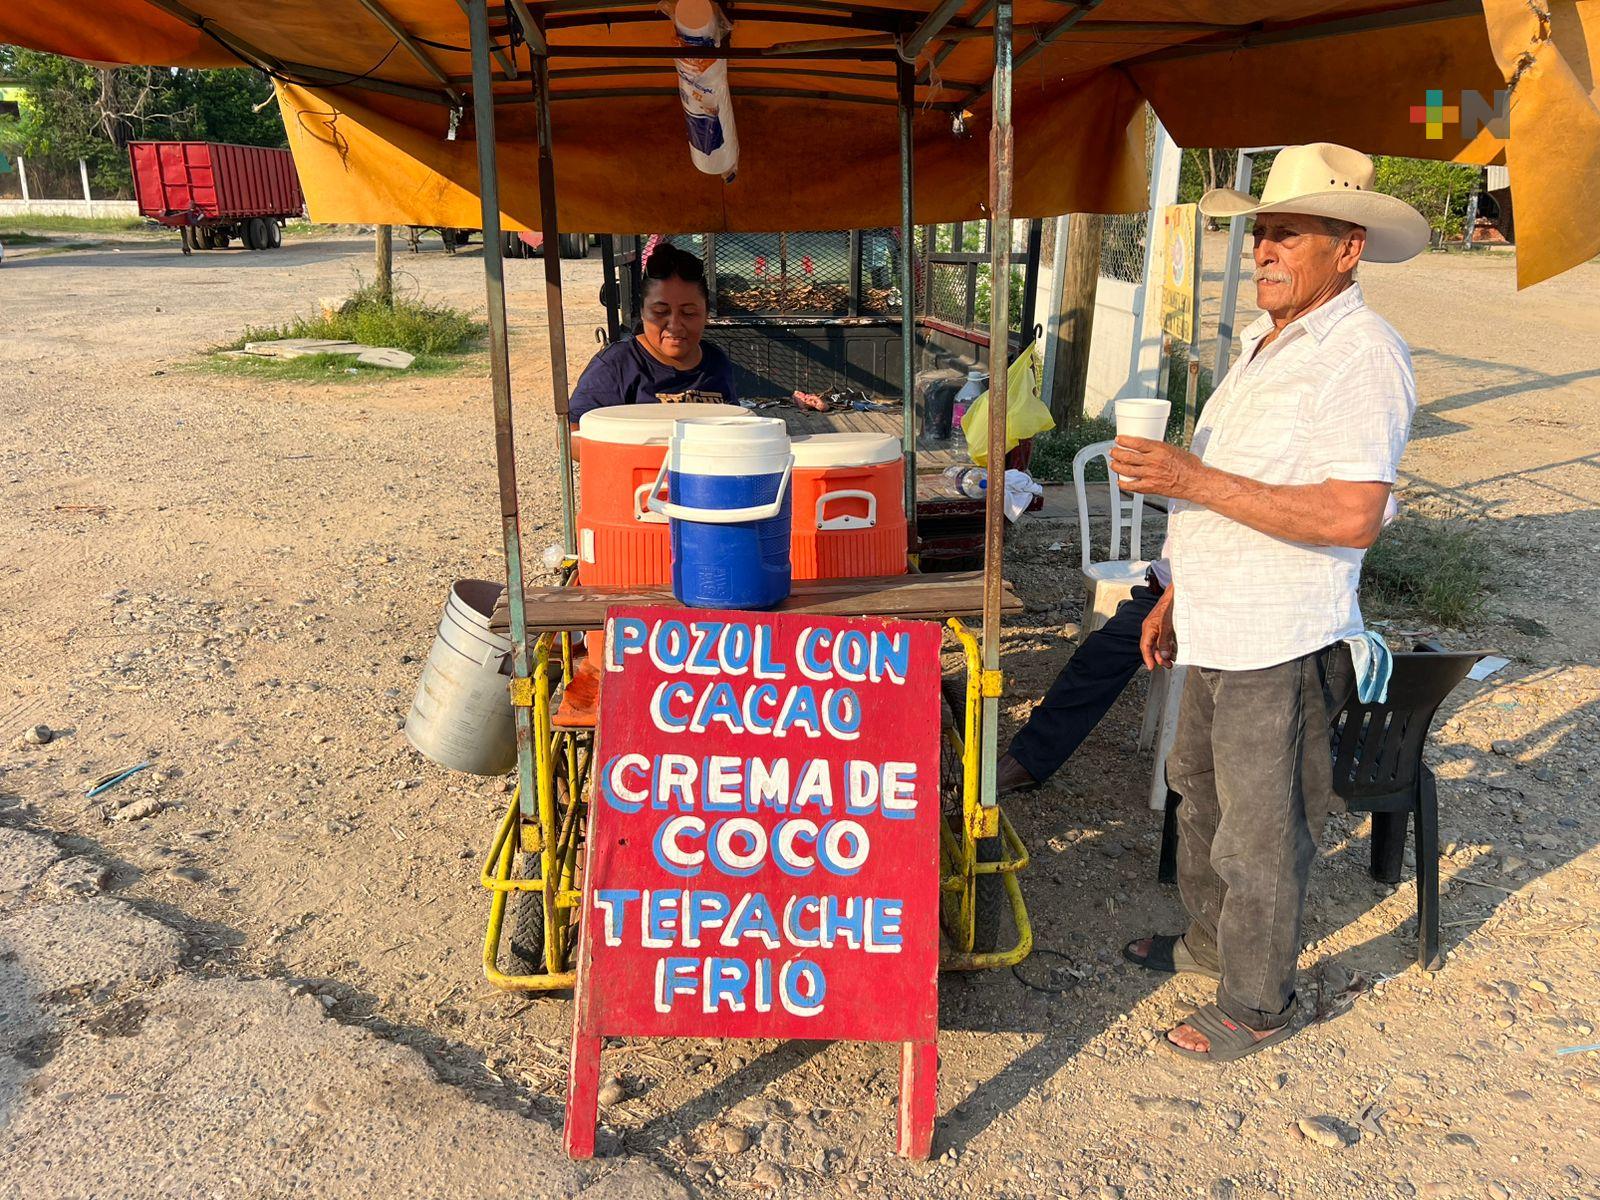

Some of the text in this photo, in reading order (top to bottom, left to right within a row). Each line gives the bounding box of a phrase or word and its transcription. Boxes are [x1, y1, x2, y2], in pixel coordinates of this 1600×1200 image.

[604, 617, 910, 684] POZOL CON
[649, 680, 862, 741] CACAO
[602, 753, 918, 819] CREMA DE
[652, 814, 871, 877] COCO
[594, 888, 904, 953] TEPACHE
[654, 956, 826, 1017] FRIO
